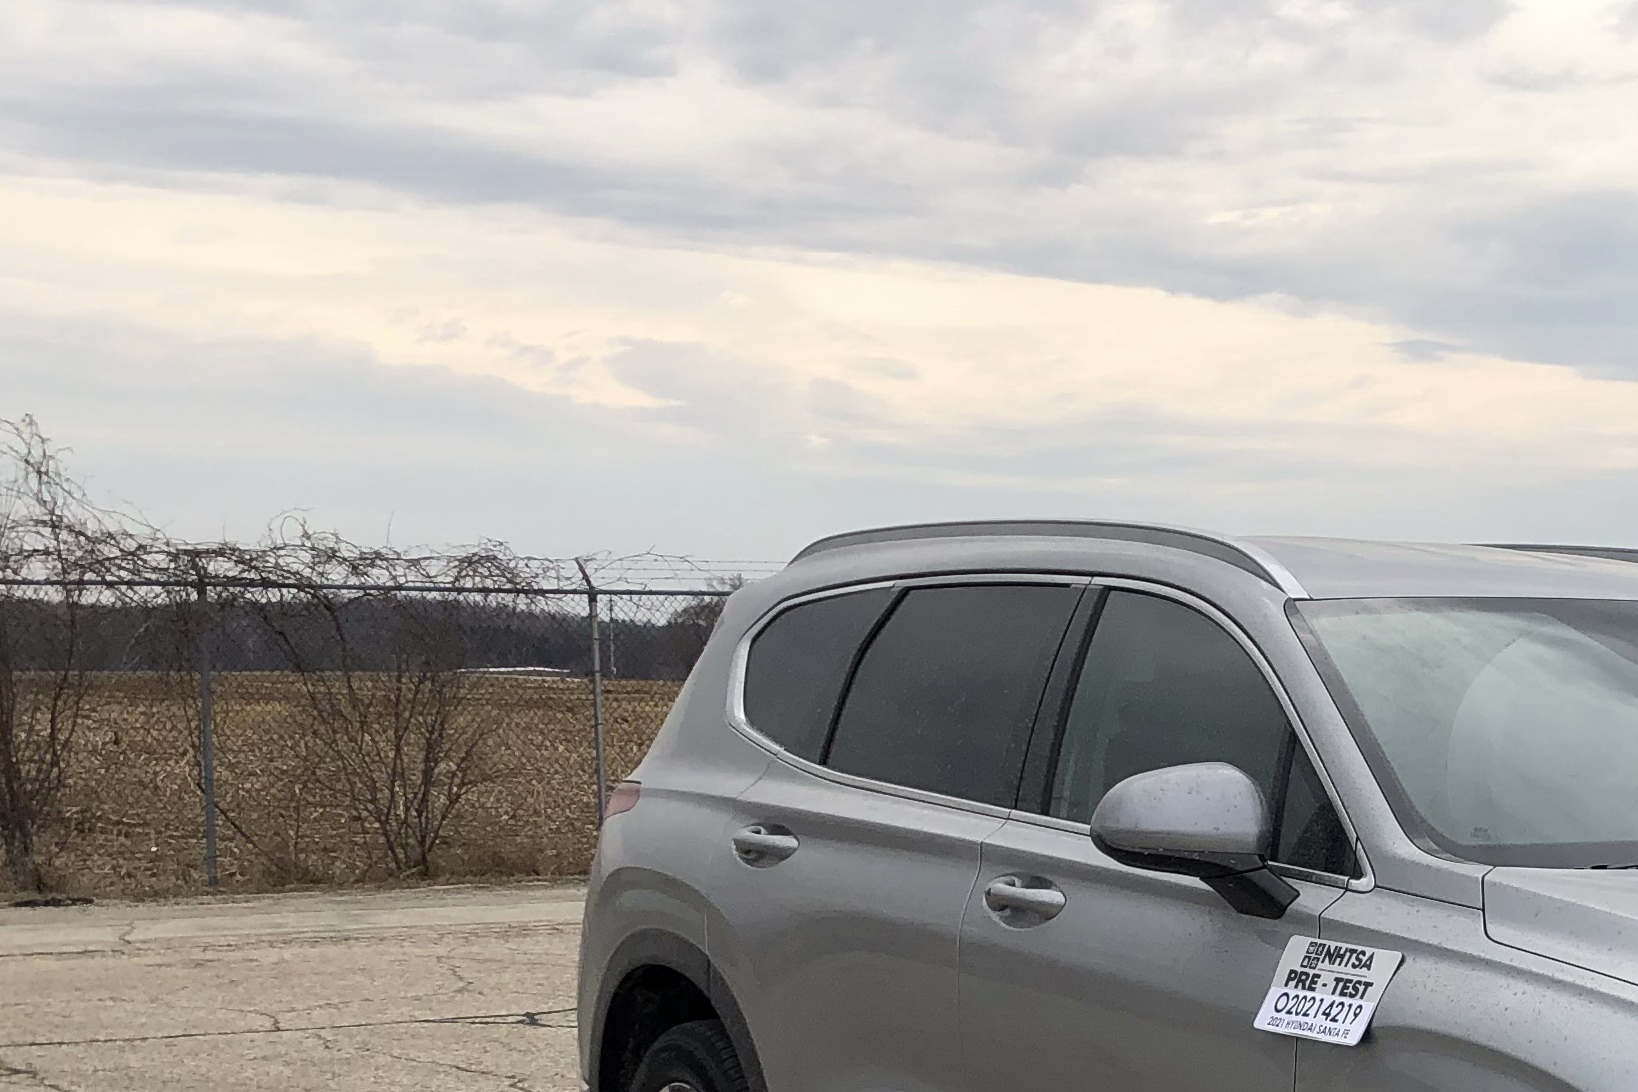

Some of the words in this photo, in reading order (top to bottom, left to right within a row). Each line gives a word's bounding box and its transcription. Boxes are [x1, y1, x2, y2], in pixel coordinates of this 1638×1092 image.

[1321, 944, 1375, 971] NHTSA
[1284, 969, 1321, 992] PRE
[1331, 977, 1374, 1000] TEST
[1267, 1016, 1285, 1028] 2021
[1285, 1020, 1317, 1034] HYUNDAI
[1316, 1024, 1340, 1037] SANTA
[1341, 1028, 1351, 1039] FE
